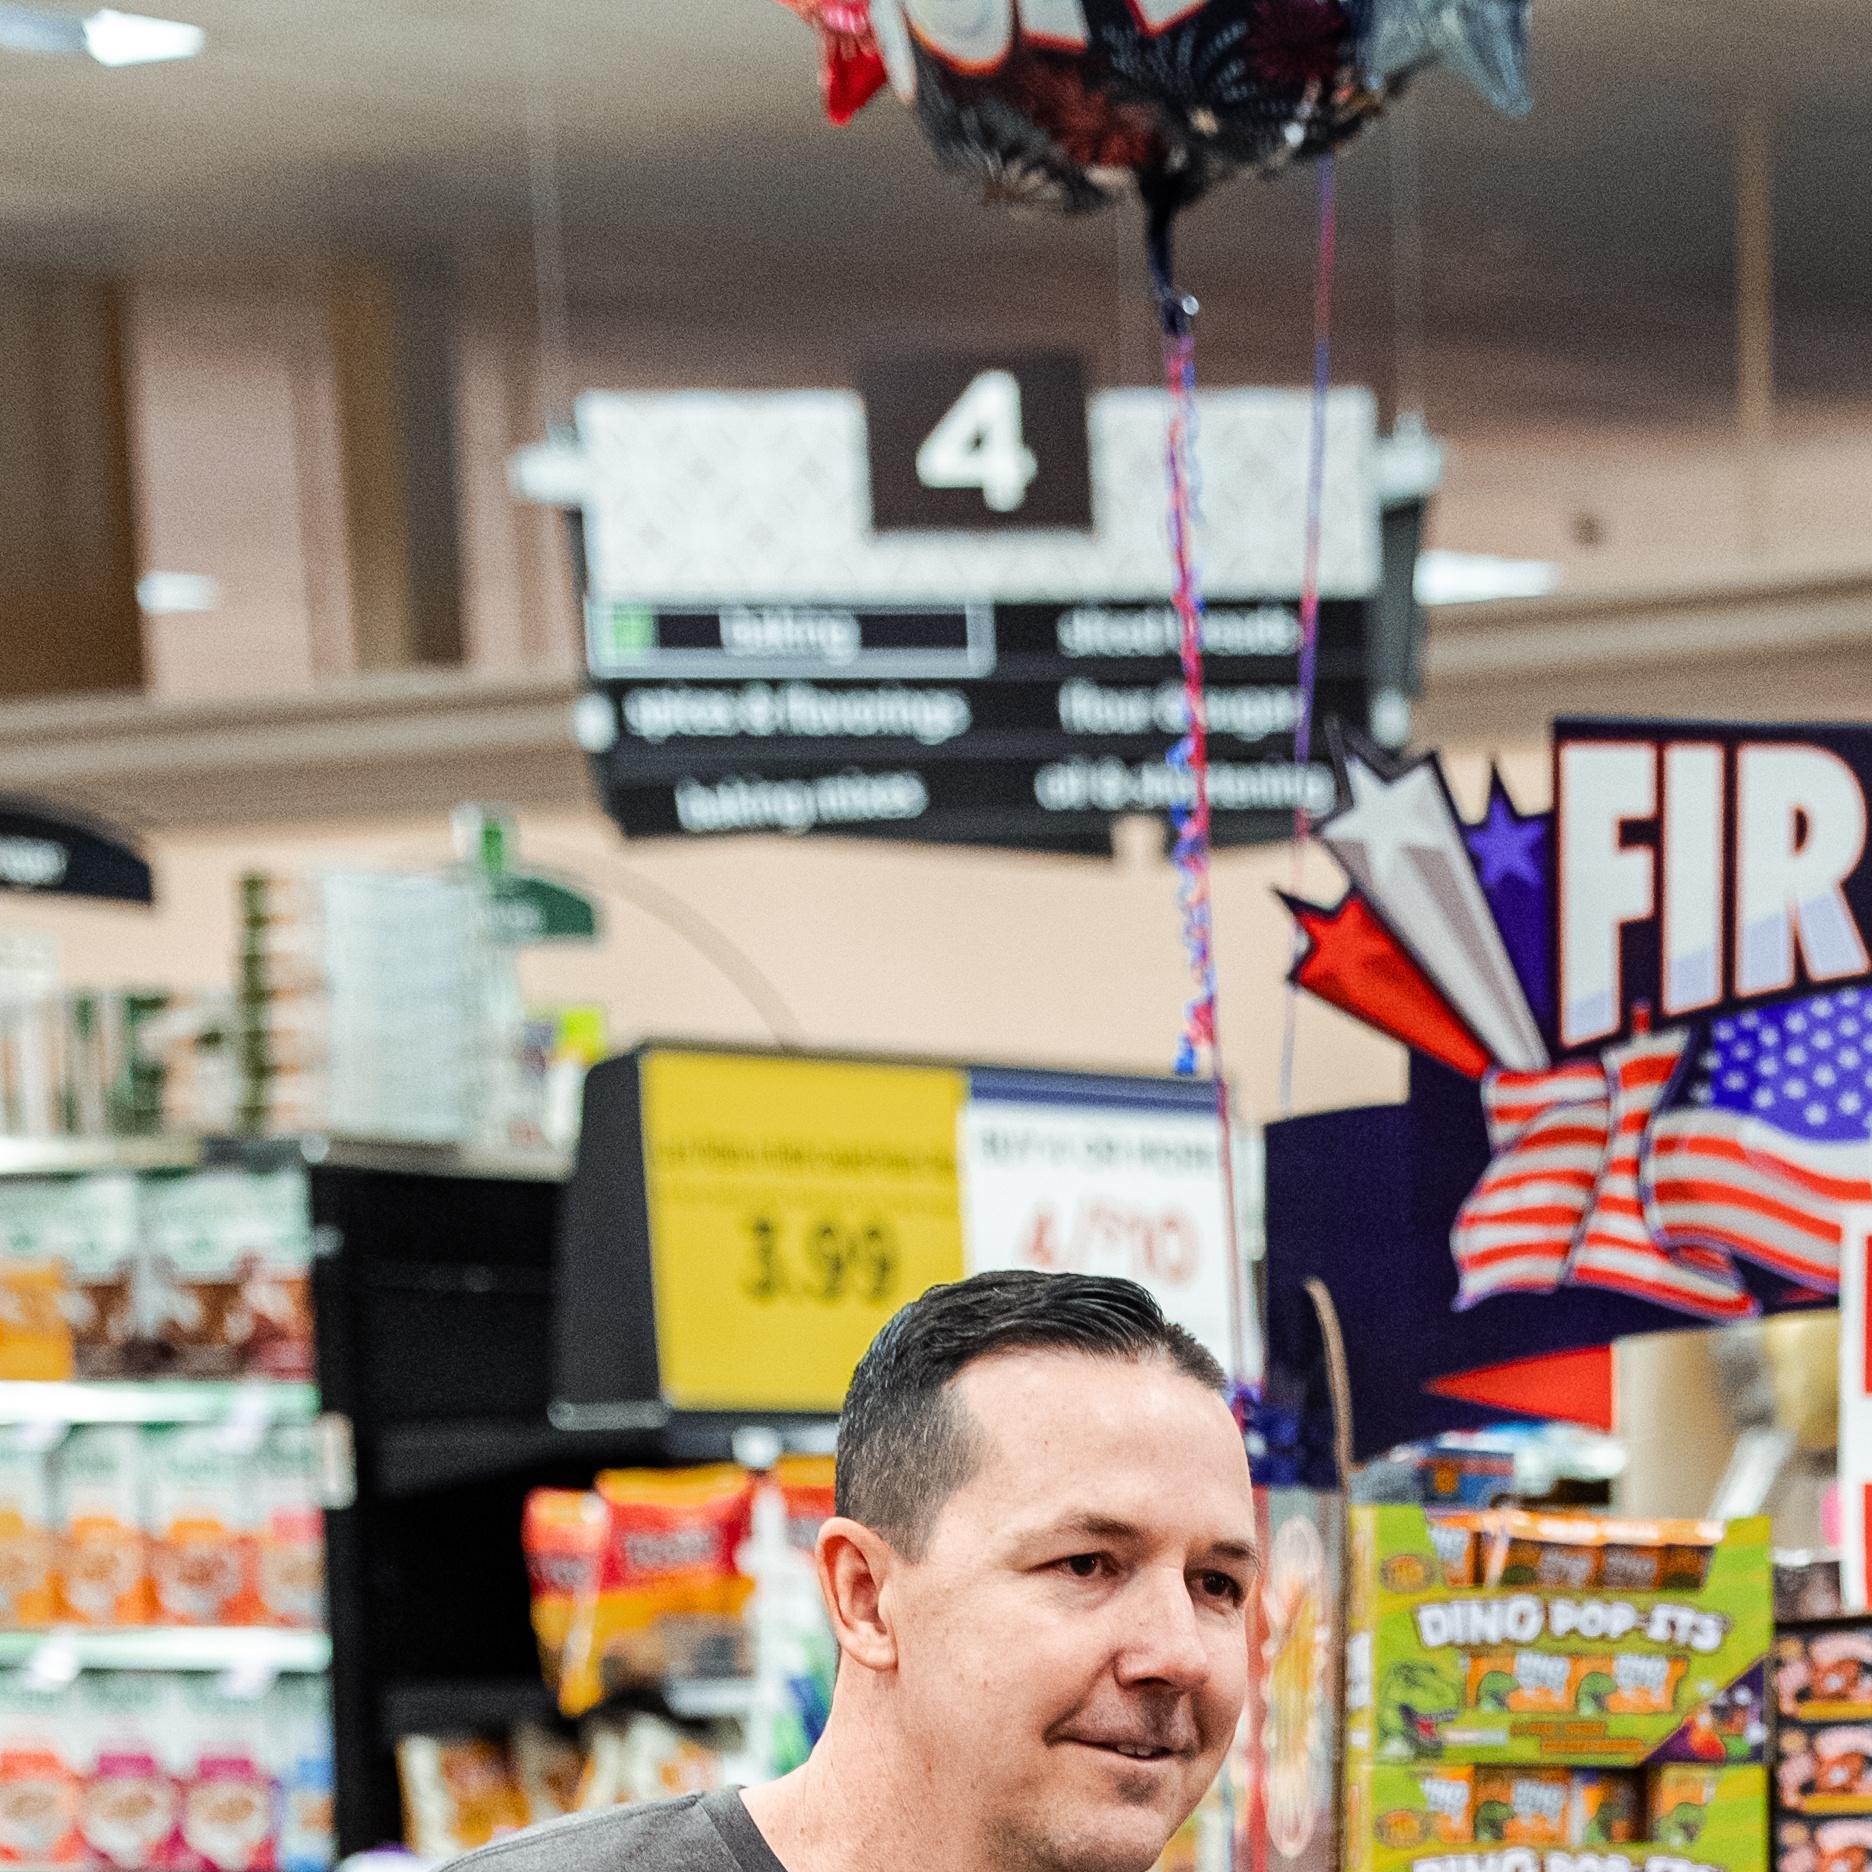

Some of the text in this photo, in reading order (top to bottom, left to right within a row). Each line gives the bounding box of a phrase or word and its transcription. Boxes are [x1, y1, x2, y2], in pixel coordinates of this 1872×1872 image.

[918, 371, 1038, 510] 4
[738, 1212, 898, 1302] 3.99
[1418, 1594, 1724, 1651] DINO POP-ITS
